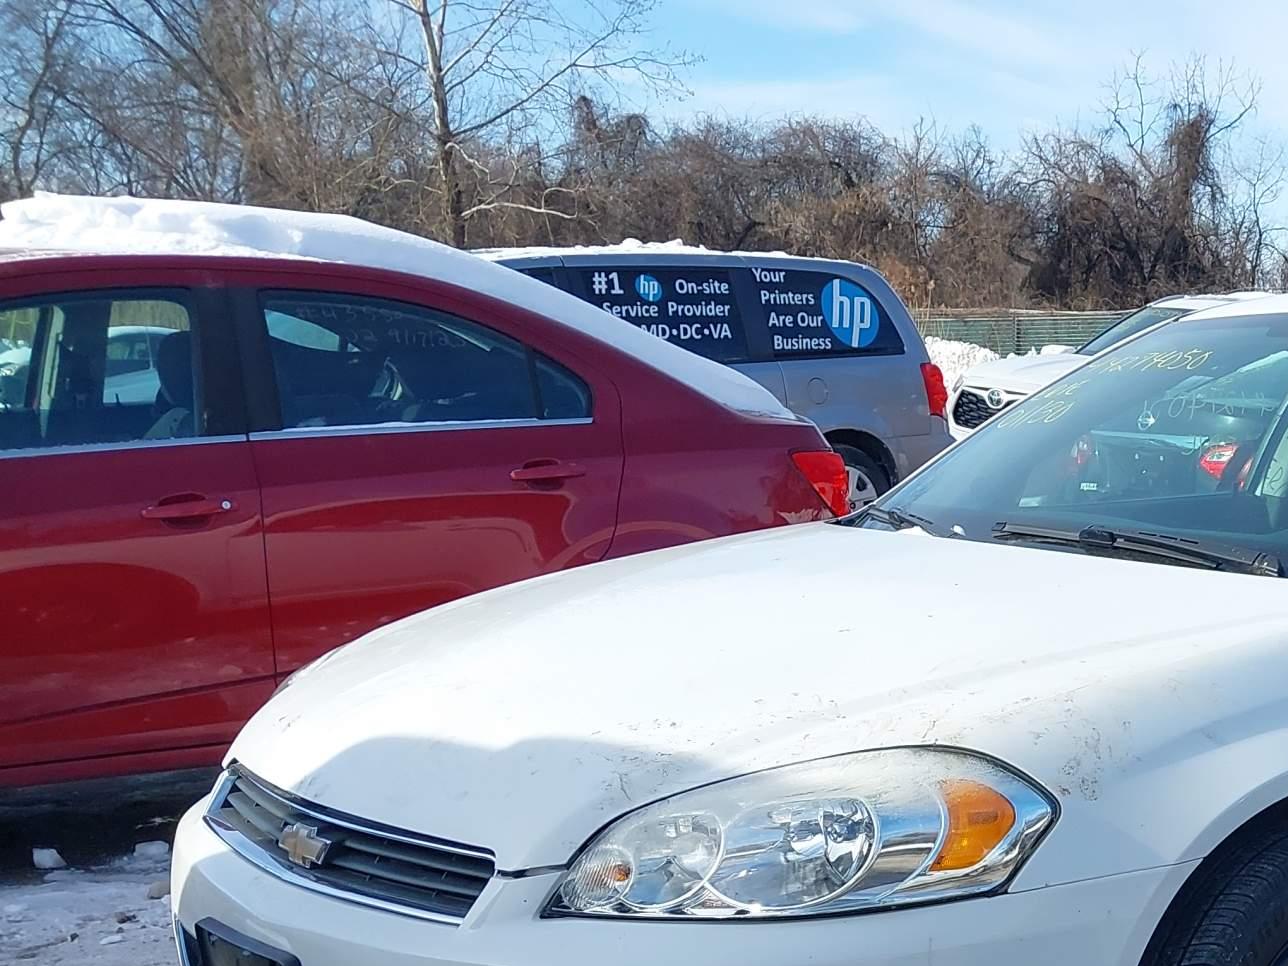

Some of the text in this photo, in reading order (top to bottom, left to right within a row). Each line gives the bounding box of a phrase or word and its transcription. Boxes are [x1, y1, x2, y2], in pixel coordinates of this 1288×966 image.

[752, 267, 786, 284] Your
[592, 272, 729, 300] #1 hp On-site
[761, 290, 815, 306] Printers
[603, 301, 730, 318] Service Provider
[832, 278, 871, 347] hp
[769, 311, 823, 328] Are Our
[774, 333, 832, 351] Business
